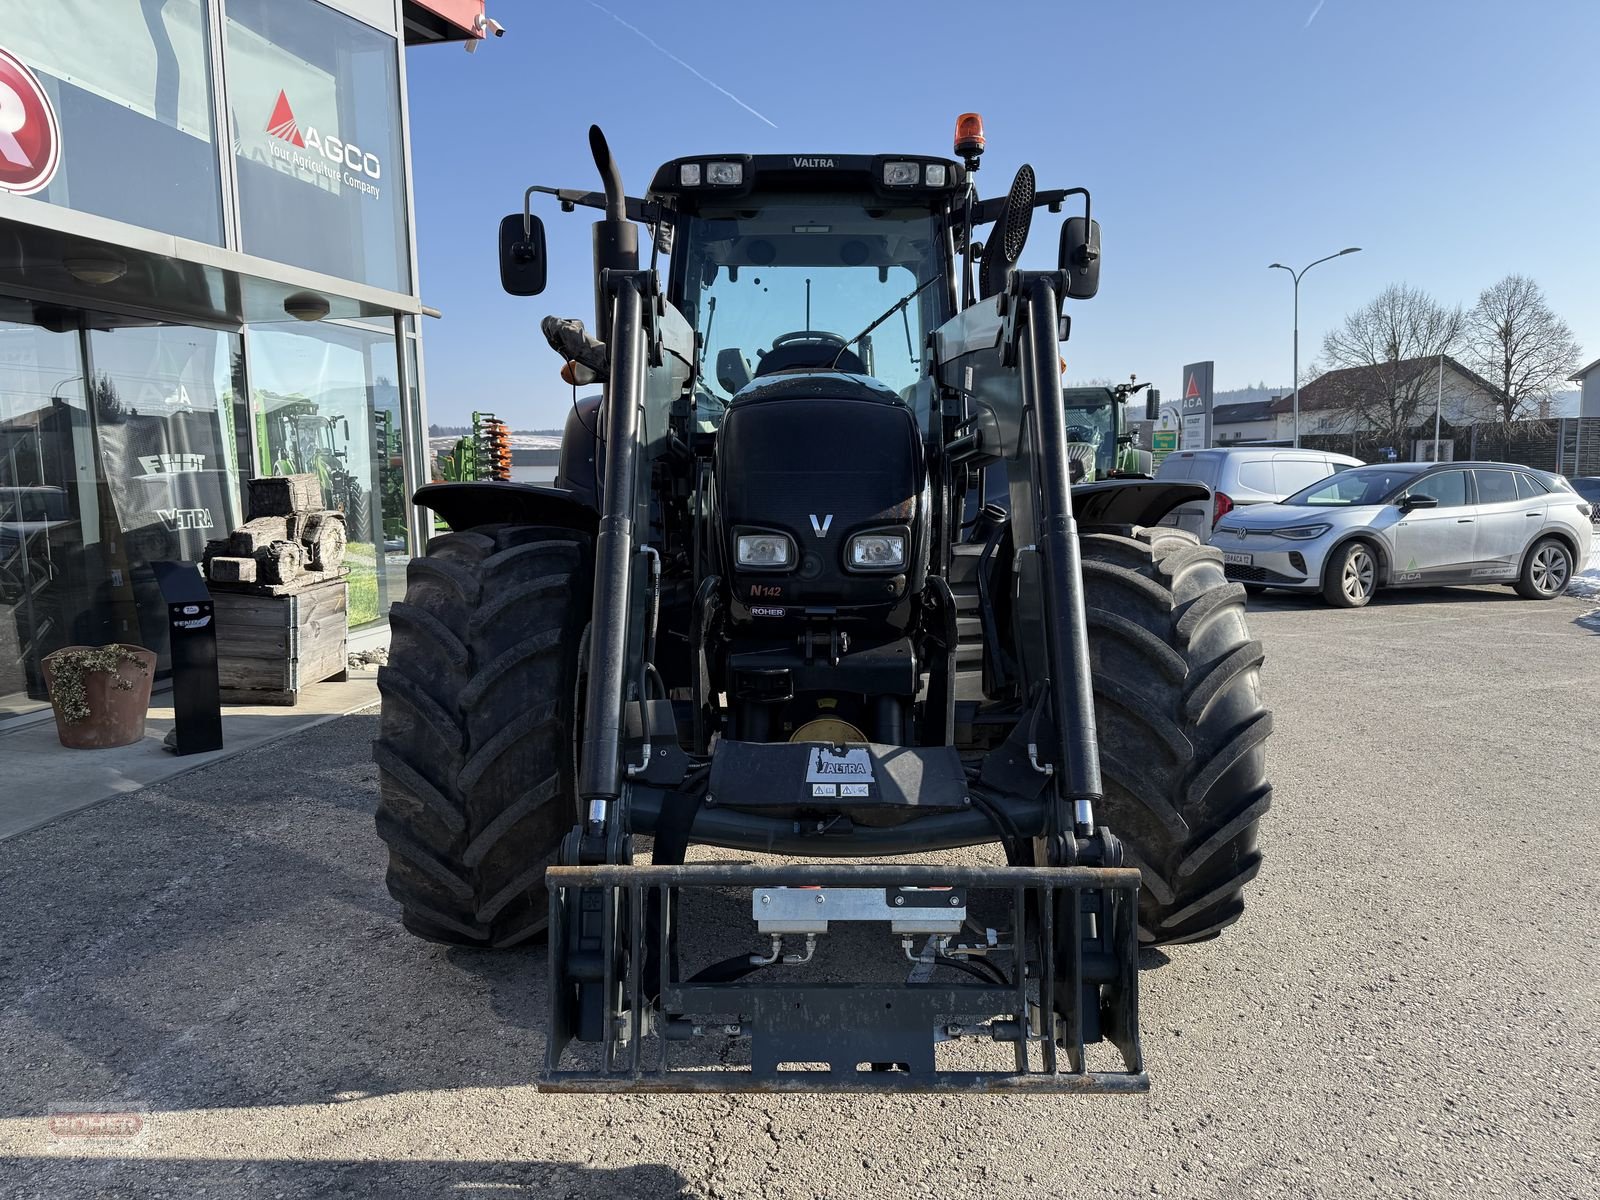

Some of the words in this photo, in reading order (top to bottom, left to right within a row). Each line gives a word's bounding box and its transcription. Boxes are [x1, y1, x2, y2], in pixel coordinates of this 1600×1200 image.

[304, 126, 381, 179] AGCO
[268, 139, 291, 160] Your
[292, 151, 342, 182] Agriculture
[343, 172, 380, 200] Company
[1183, 397, 1203, 409] ACA
[809, 514, 834, 538] V
[1400, 573, 1421, 581] ACA
